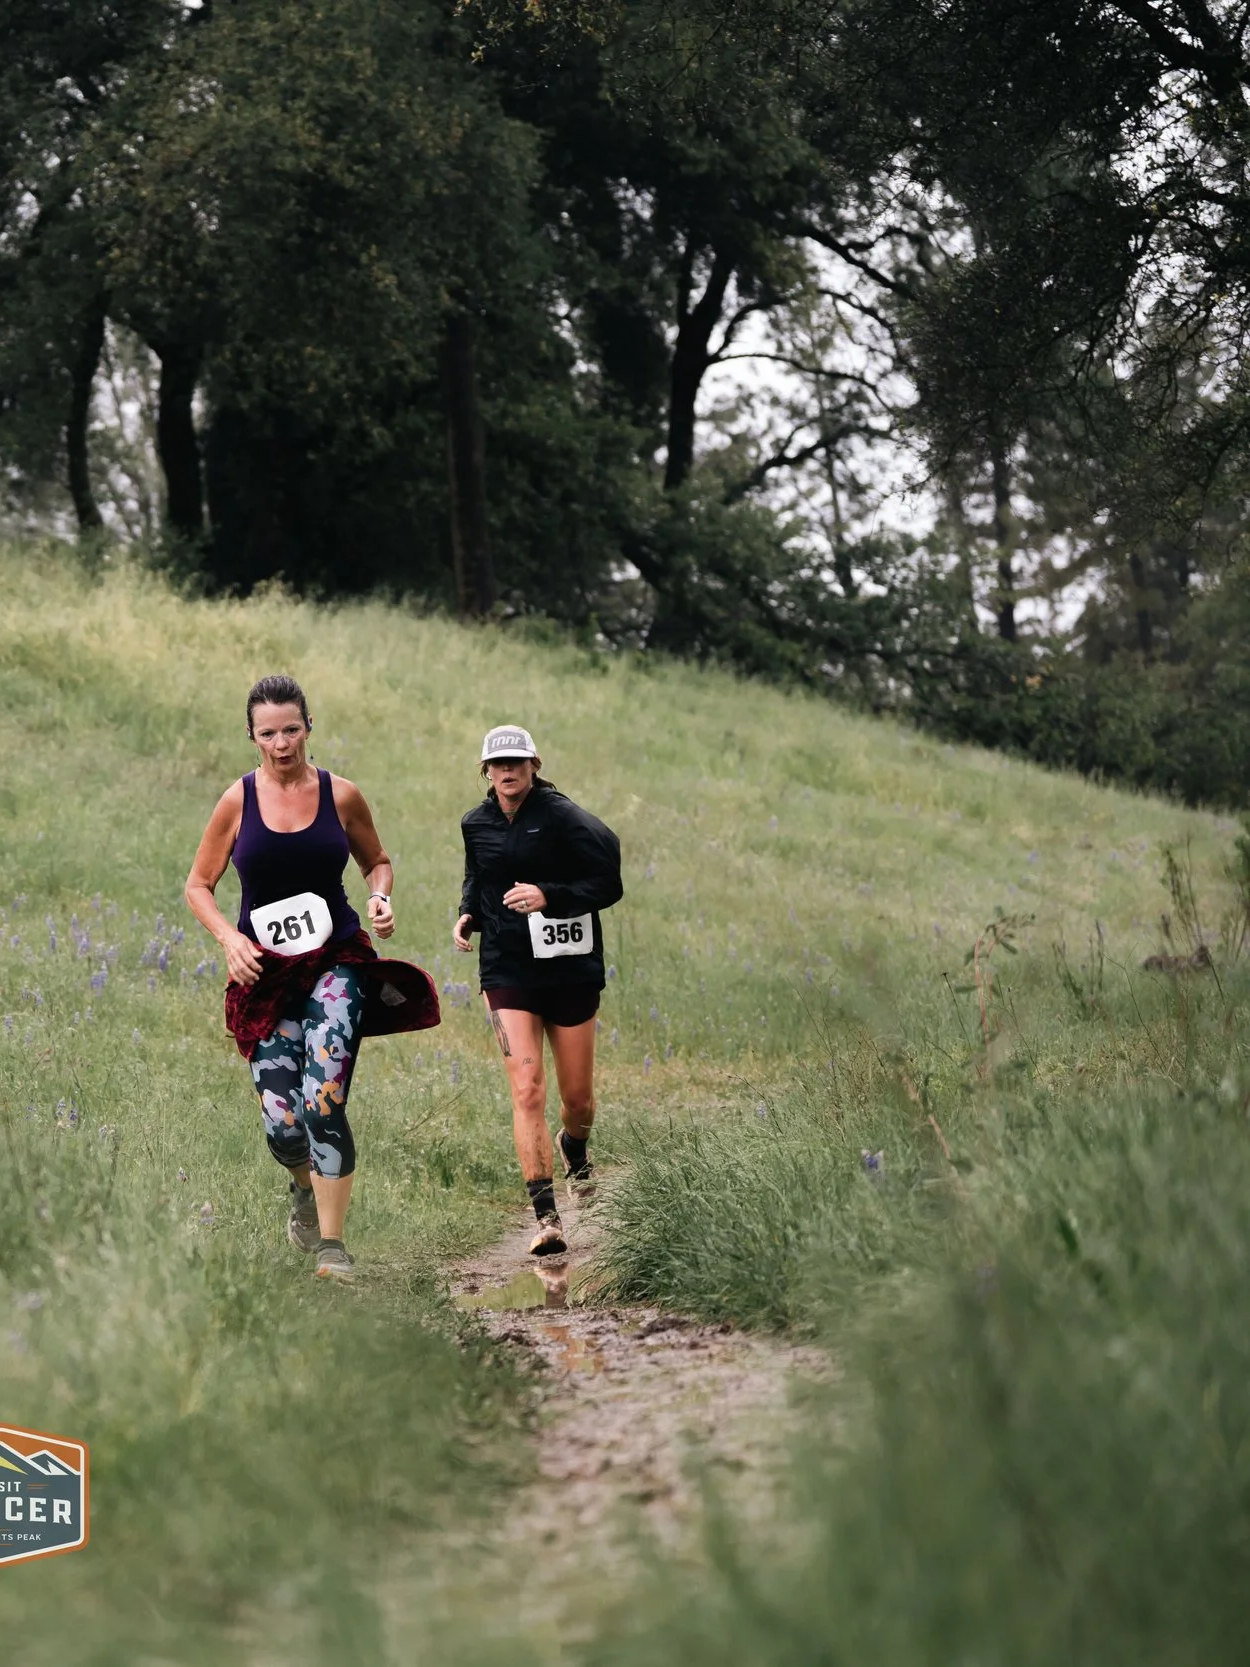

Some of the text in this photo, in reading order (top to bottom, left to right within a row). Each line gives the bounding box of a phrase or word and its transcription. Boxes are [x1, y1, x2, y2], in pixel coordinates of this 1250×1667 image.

[491, 735, 521, 748] rnnr
[267, 910, 315, 946] 261
[542, 922, 583, 945] 356
